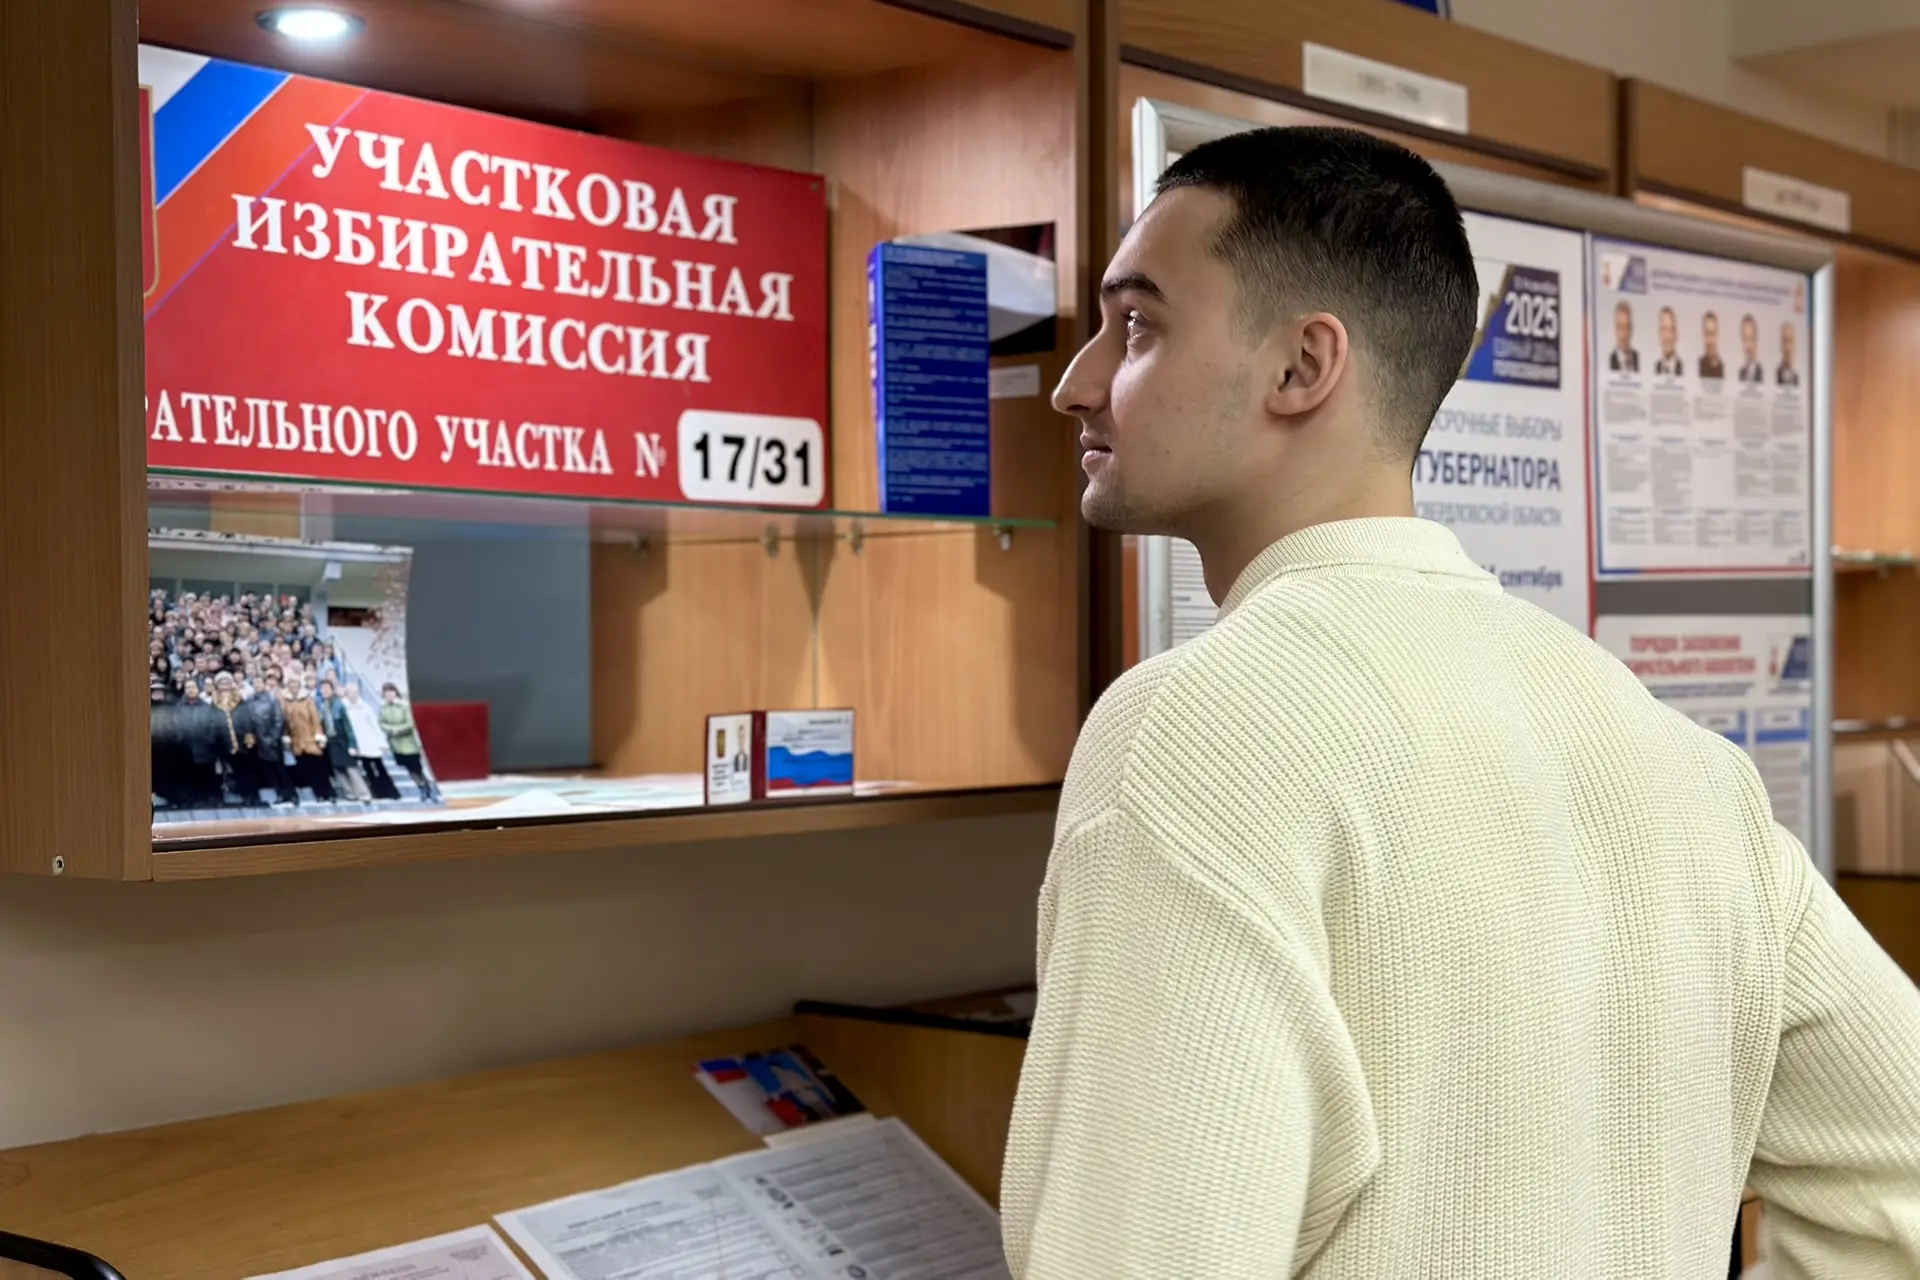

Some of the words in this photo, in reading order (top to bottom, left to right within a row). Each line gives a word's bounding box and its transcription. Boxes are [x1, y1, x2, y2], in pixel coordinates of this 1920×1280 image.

[305, 122, 739, 246] УЧАСТКОВАЯ
[231, 192, 794, 322] ИЗБИРАТЕЛЬНАЯ
[345, 289, 711, 384] КОМИССИЯ
[1504, 291, 1558, 341] 2025
[145, 389, 419, 462] АТЕЛЬНОГО
[435, 413, 613, 476] УЧАСТКА
[633, 430, 668, 479] №
[693, 431, 811, 491] 17/31
[1416, 449, 1561, 492] ГУБЕРНАТОРА
